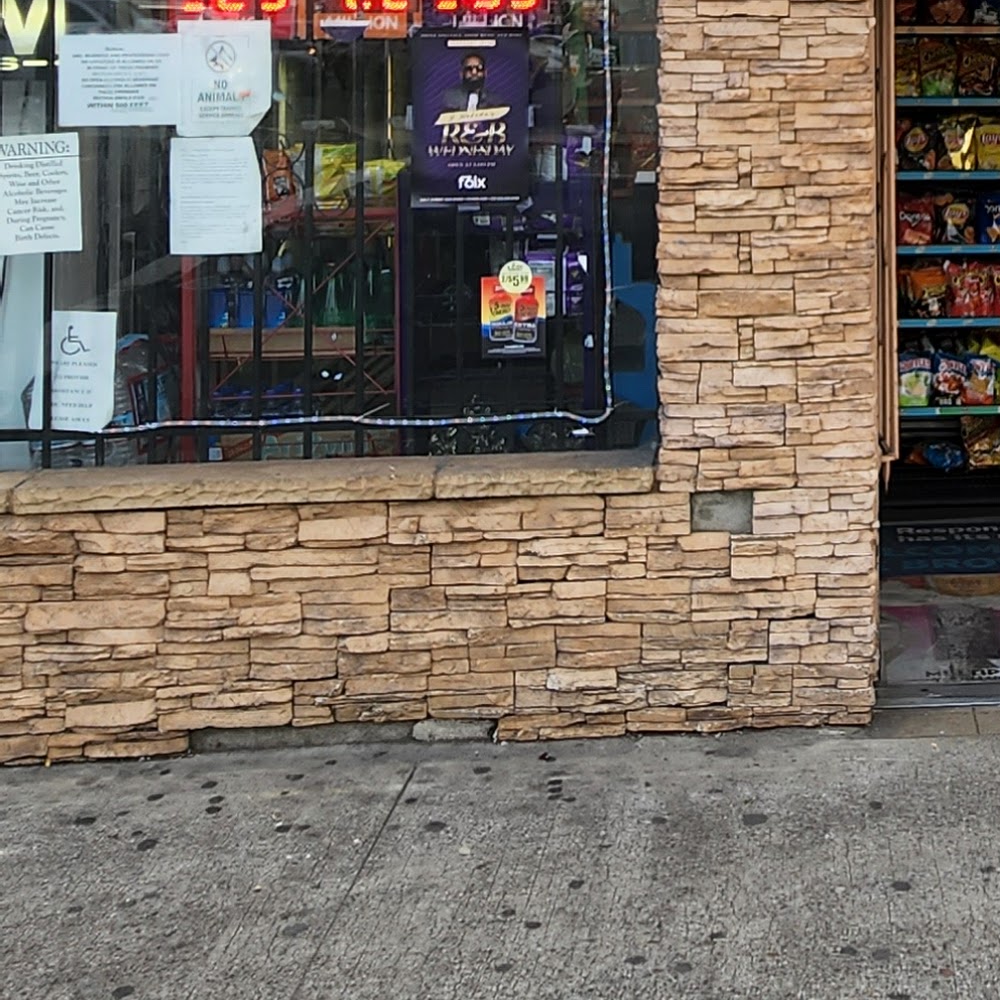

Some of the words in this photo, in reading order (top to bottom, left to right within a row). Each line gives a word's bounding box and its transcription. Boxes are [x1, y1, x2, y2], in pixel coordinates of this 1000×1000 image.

[213, 80, 228, 90] NO
[197, 91, 250, 102] ANIMAL
[898, 534, 934, 543] has
[954, 532, 991, 541] its
